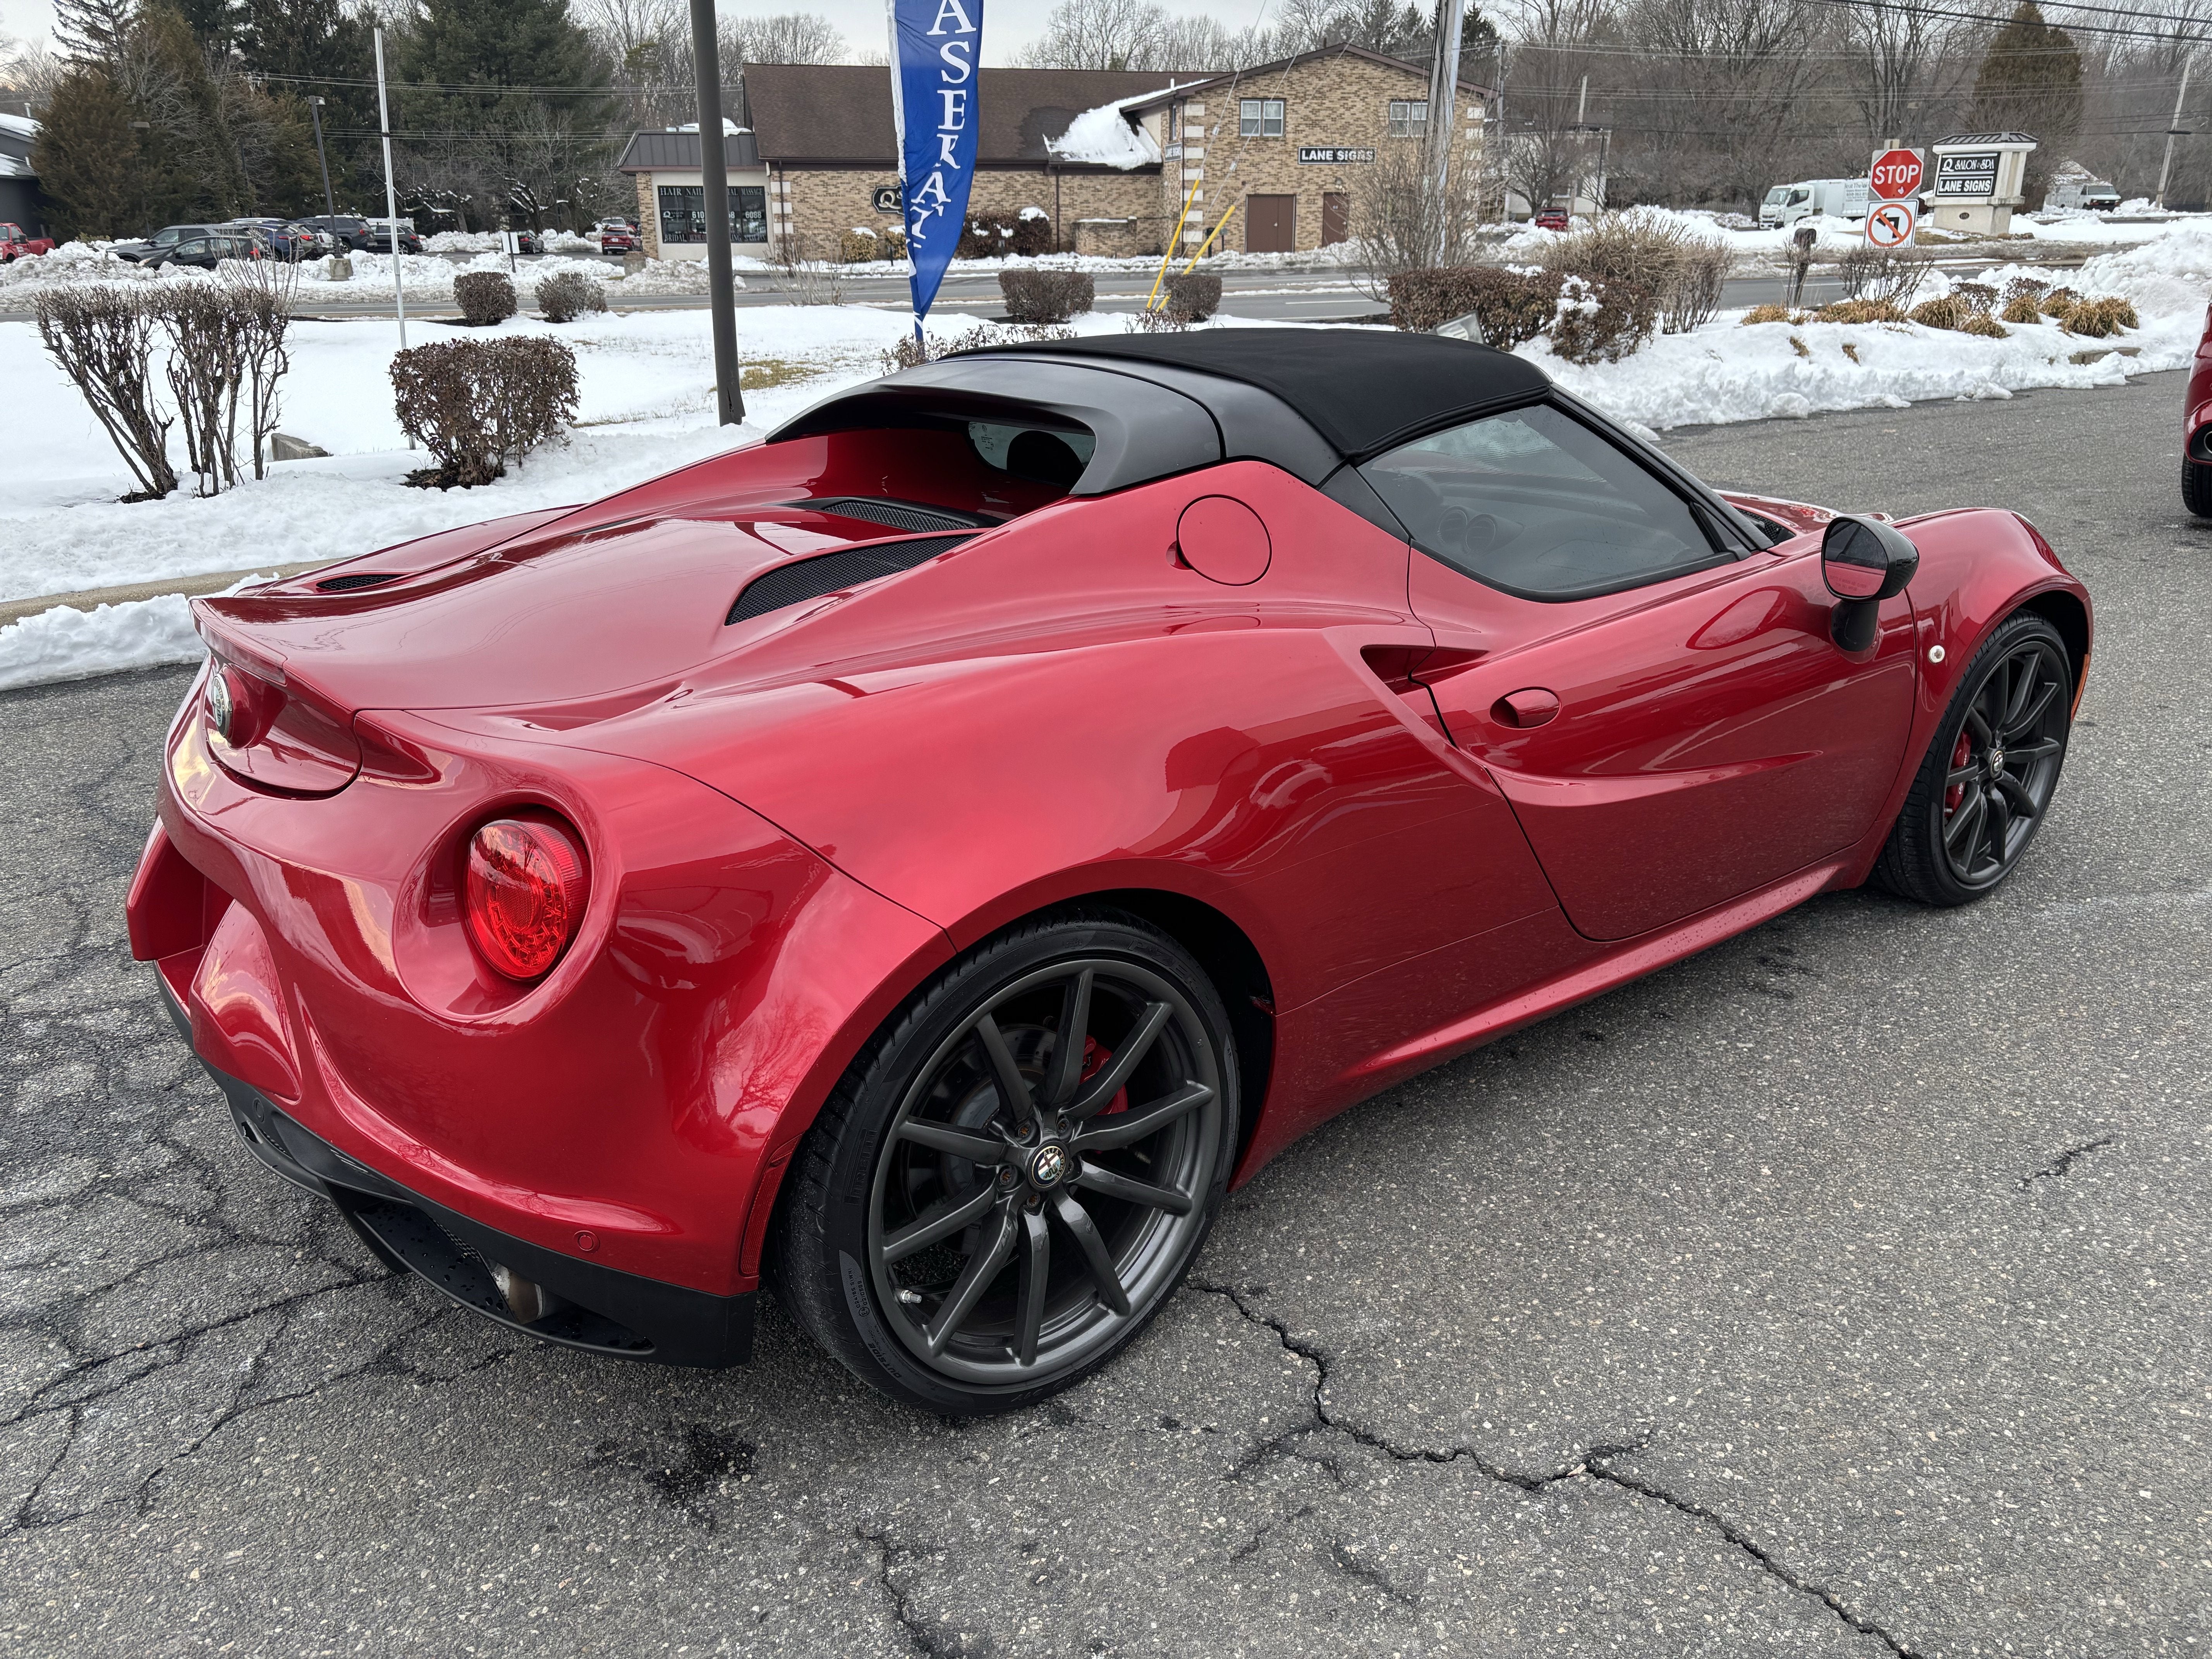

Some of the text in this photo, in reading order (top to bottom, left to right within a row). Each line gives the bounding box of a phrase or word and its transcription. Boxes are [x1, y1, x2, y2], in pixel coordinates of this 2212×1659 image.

[1302, 150, 1373, 161] LANE SIGNS
[1942, 158, 1954, 172] Q
[1874, 164, 1919, 185] STOP
[660, 187, 682, 196] HAIR
[1939, 180, 1991, 192] LANE SIGNS
[878, 191, 902, 209] Q
[664, 234, 687, 242] BRIDAL
[1044, 1148, 1064, 1179] ALFA ROMEO
[868, 1343, 902, 1378] OUTSIDE
